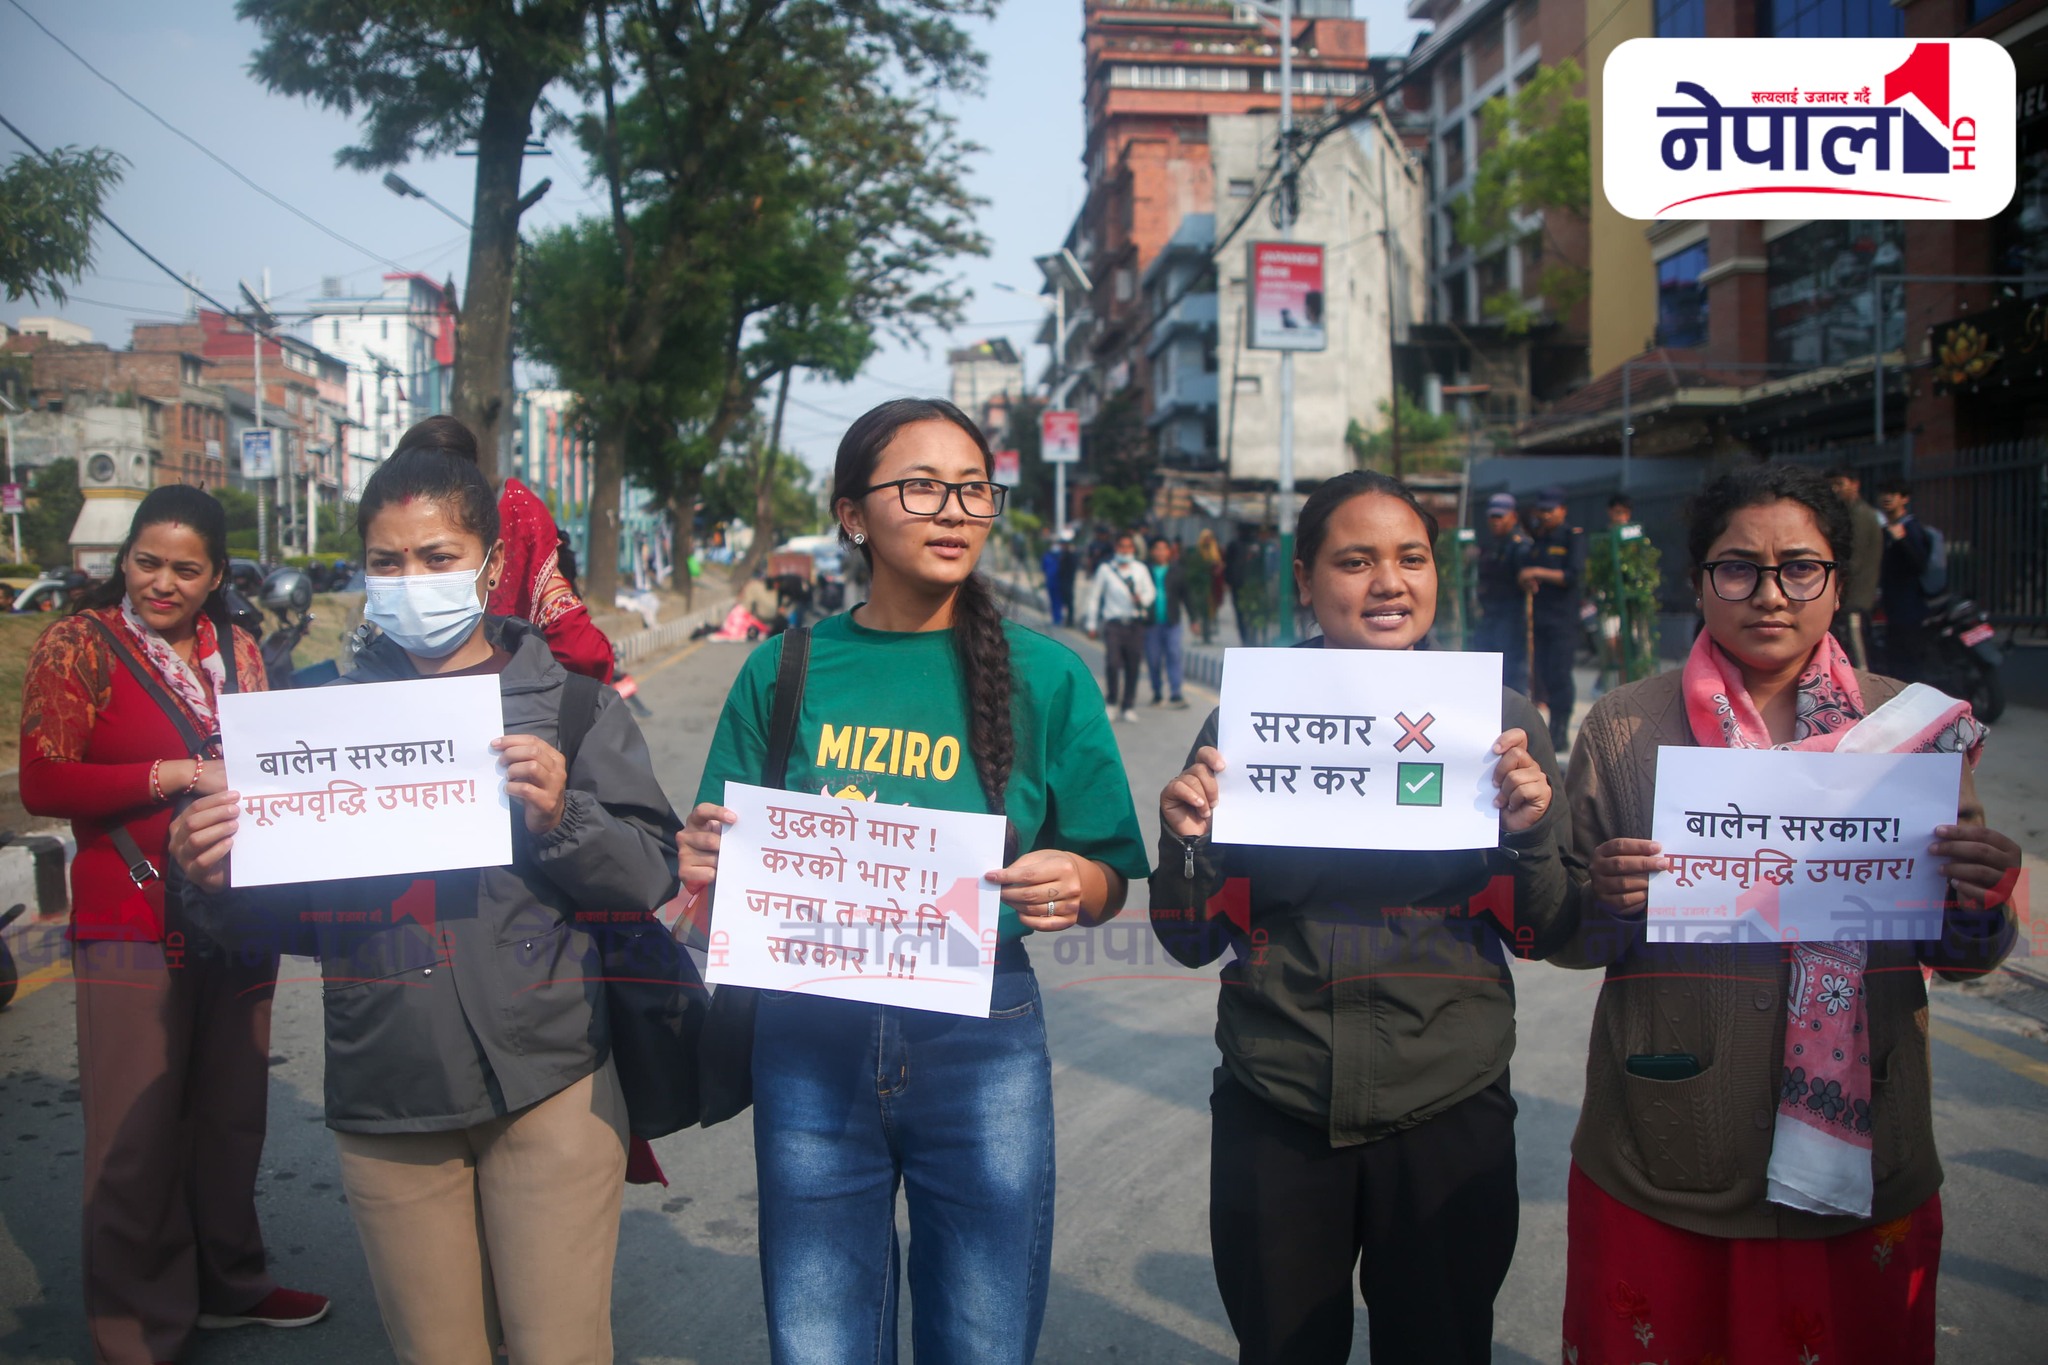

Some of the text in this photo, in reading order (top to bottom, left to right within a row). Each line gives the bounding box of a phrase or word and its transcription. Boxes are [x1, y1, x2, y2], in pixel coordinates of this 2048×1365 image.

[1250, 712, 1376, 747] सरकार
[256, 739, 455, 776] बालेन सरकार!
[815, 723, 961, 782] MIZIRO
[1246, 764, 1371, 798] सर कर
[242, 779, 477, 827] मूल्यवृद्धि उपहार!
[1685, 802, 1901, 844] बालेन सरकार!
[766, 806, 859, 842] युद्धको
[867, 819, 920, 851] मार
[761, 846, 848, 883] करको
[857, 859, 911, 892] भार
[1664, 848, 1916, 890] मूल्यवृद्धि उपहार!
[745, 888, 950, 940] जनता त मरे नि
[766, 935, 869, 974] सरकार
